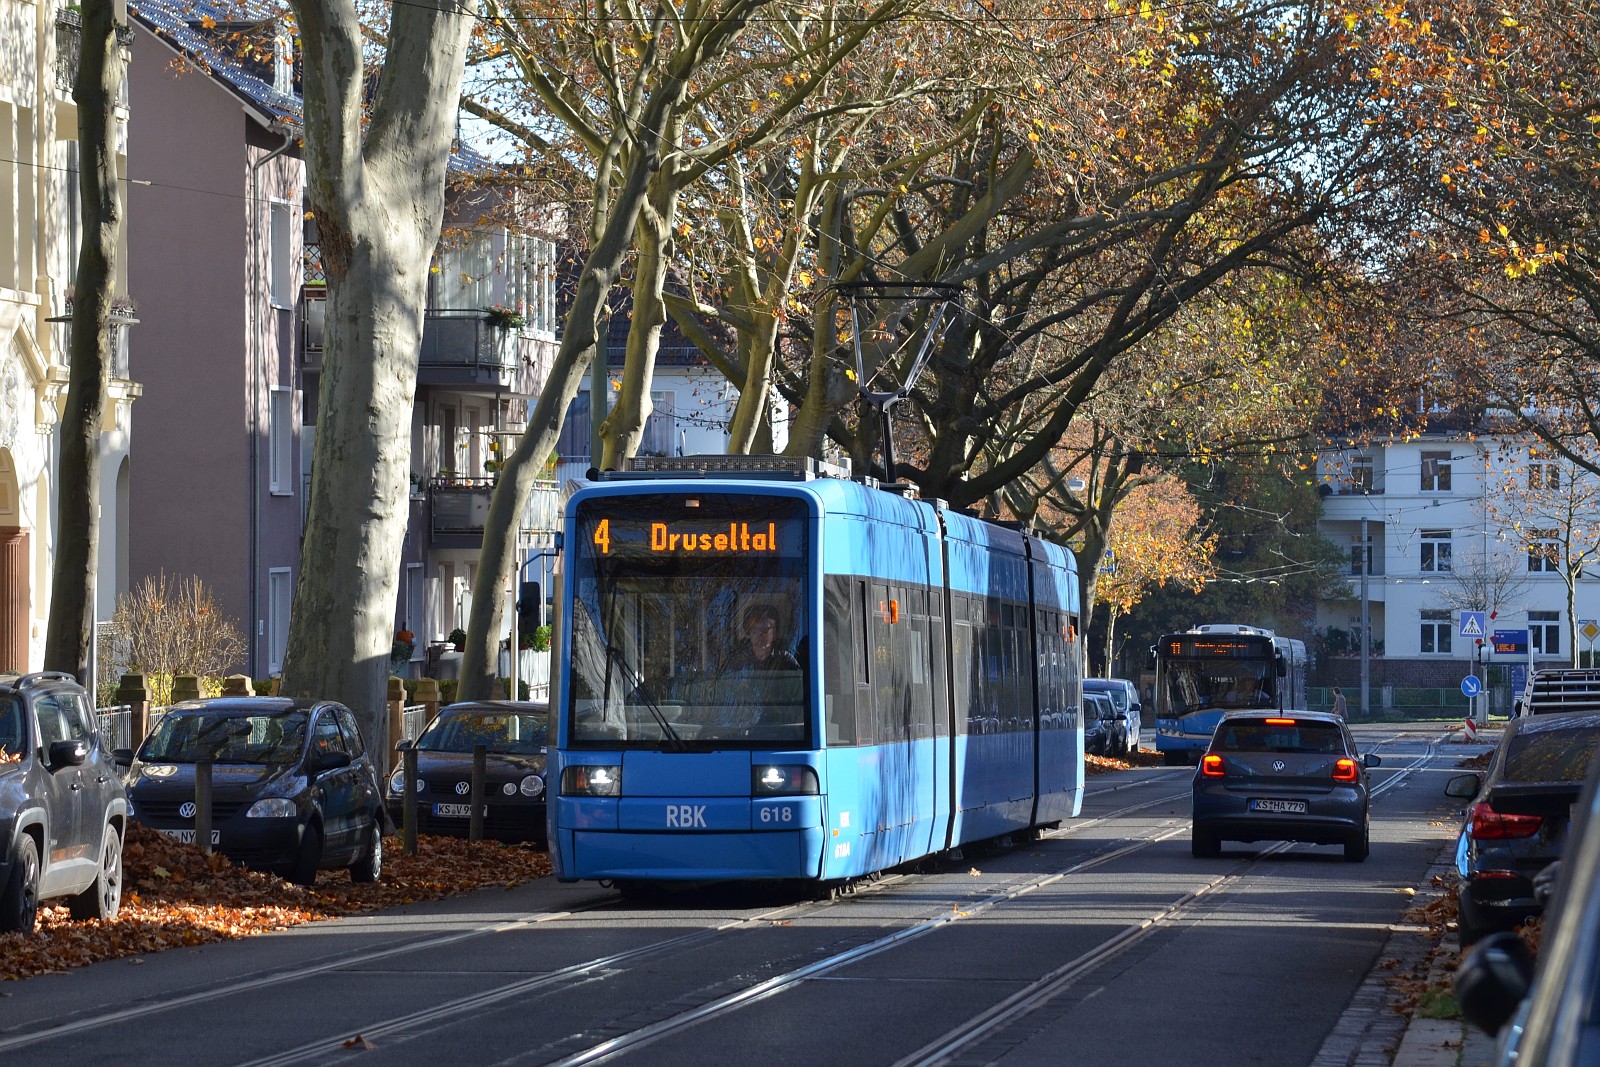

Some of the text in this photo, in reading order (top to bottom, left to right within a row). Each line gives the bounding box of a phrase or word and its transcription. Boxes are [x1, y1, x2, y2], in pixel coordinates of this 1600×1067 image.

[594, 519, 776, 553] 4 Druseltal
[1171, 642, 1181, 654] 11
[438, 804, 450, 814] KS
[1256, 800, 1305, 812] KS HA 779
[666, 805, 707, 828] RBK
[760, 806, 792, 822] 618
